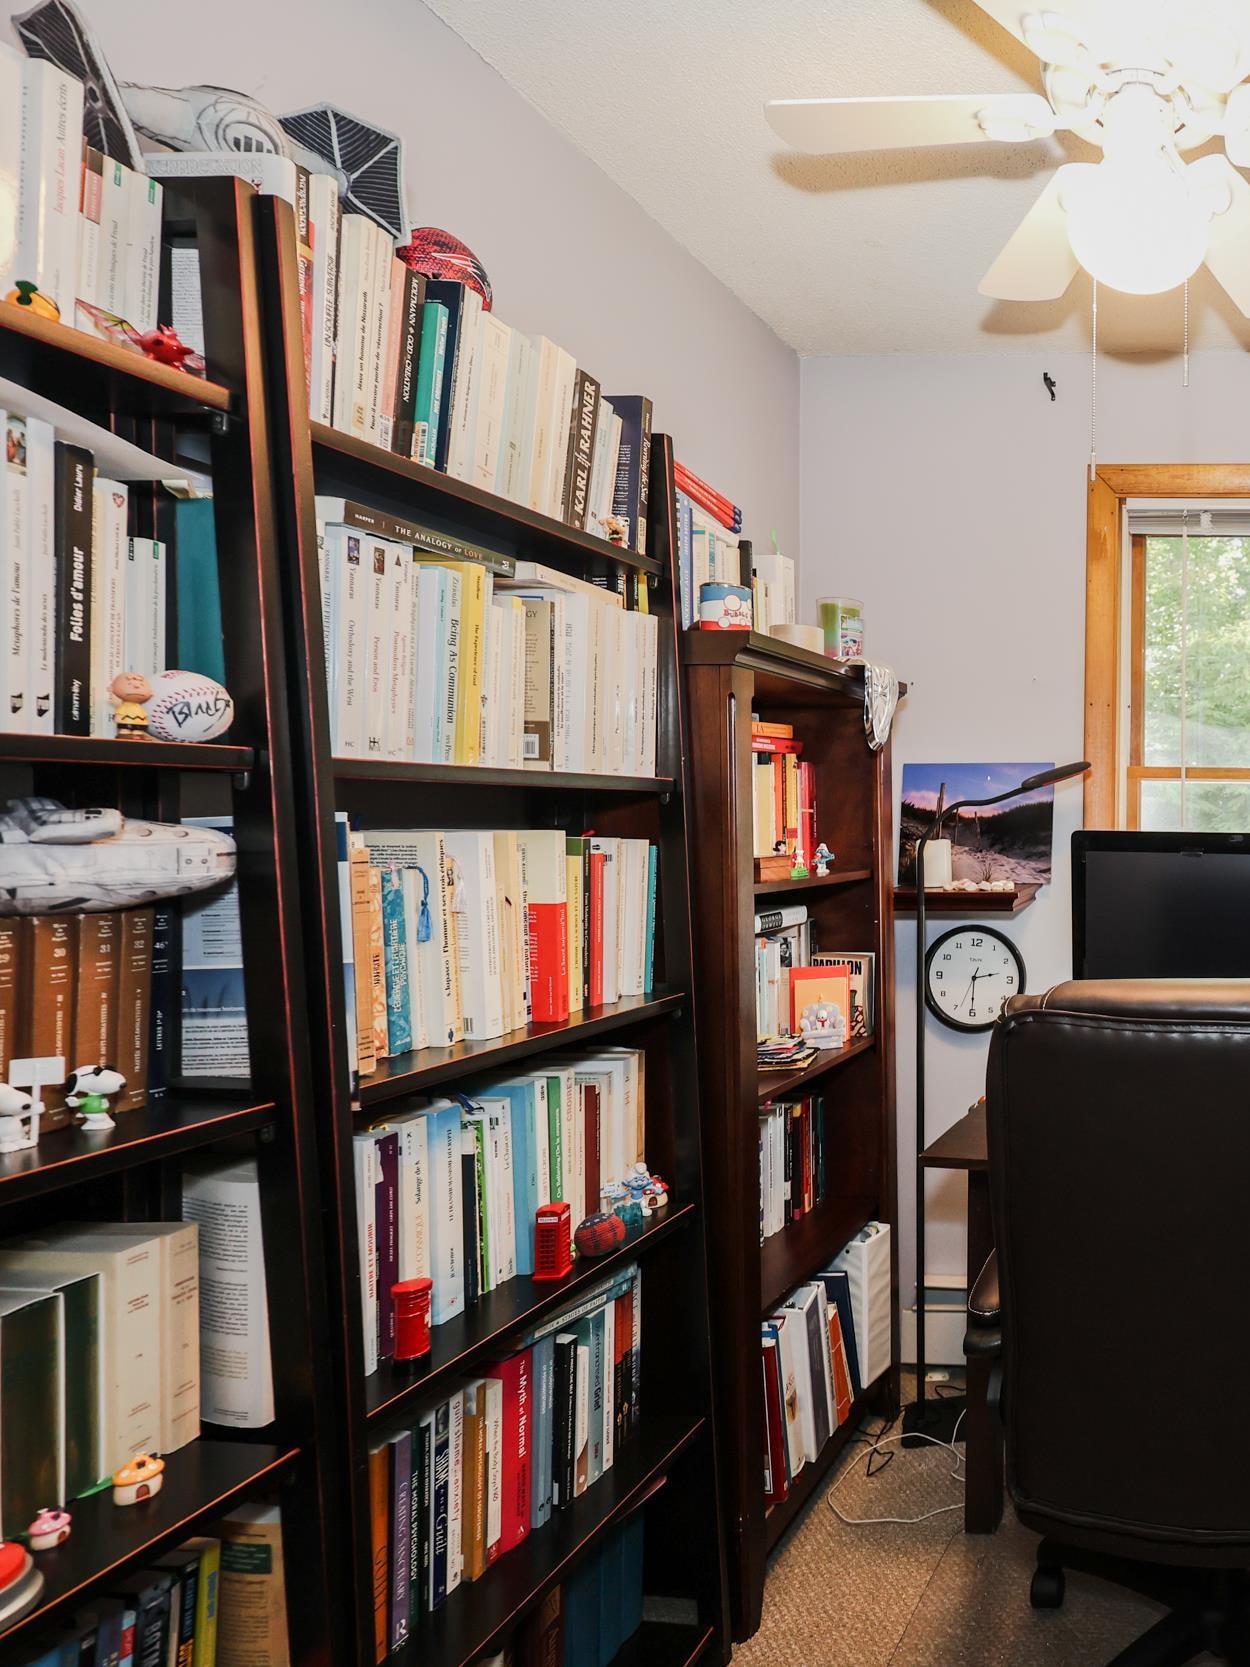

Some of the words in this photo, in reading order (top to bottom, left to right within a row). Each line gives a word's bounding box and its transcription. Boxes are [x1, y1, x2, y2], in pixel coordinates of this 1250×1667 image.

[408, 277, 419, 326] MOLTMANN
[406, 335, 414, 353] GOD
[403, 360, 412, 402] CREATION
[580, 381, 596, 453] RAHNER
[574, 468, 588, 515] KARL
[395, 525, 411, 537] THE
[415, 532, 452, 550] ANALOGY
[464, 549, 483, 560] LOVE
[70, 546, 84, 600] d'amour
[70, 603, 84, 641] Folies
[447, 619, 459, 646] Being
[449, 650, 458, 663] As
[446, 666, 458, 724] Communion
[971, 938, 983, 947] 12
[936, 971, 943, 979] 9
[1006, 976, 1013, 984] 3
[969, 1008, 976, 1016] 6
[517, 1375, 527, 1404] Myth
[517, 1416, 526, 1458] Normal
[410, 1522, 418, 1580] PSYCHOLOGY
[435, 1514, 447, 1555] Guilt
